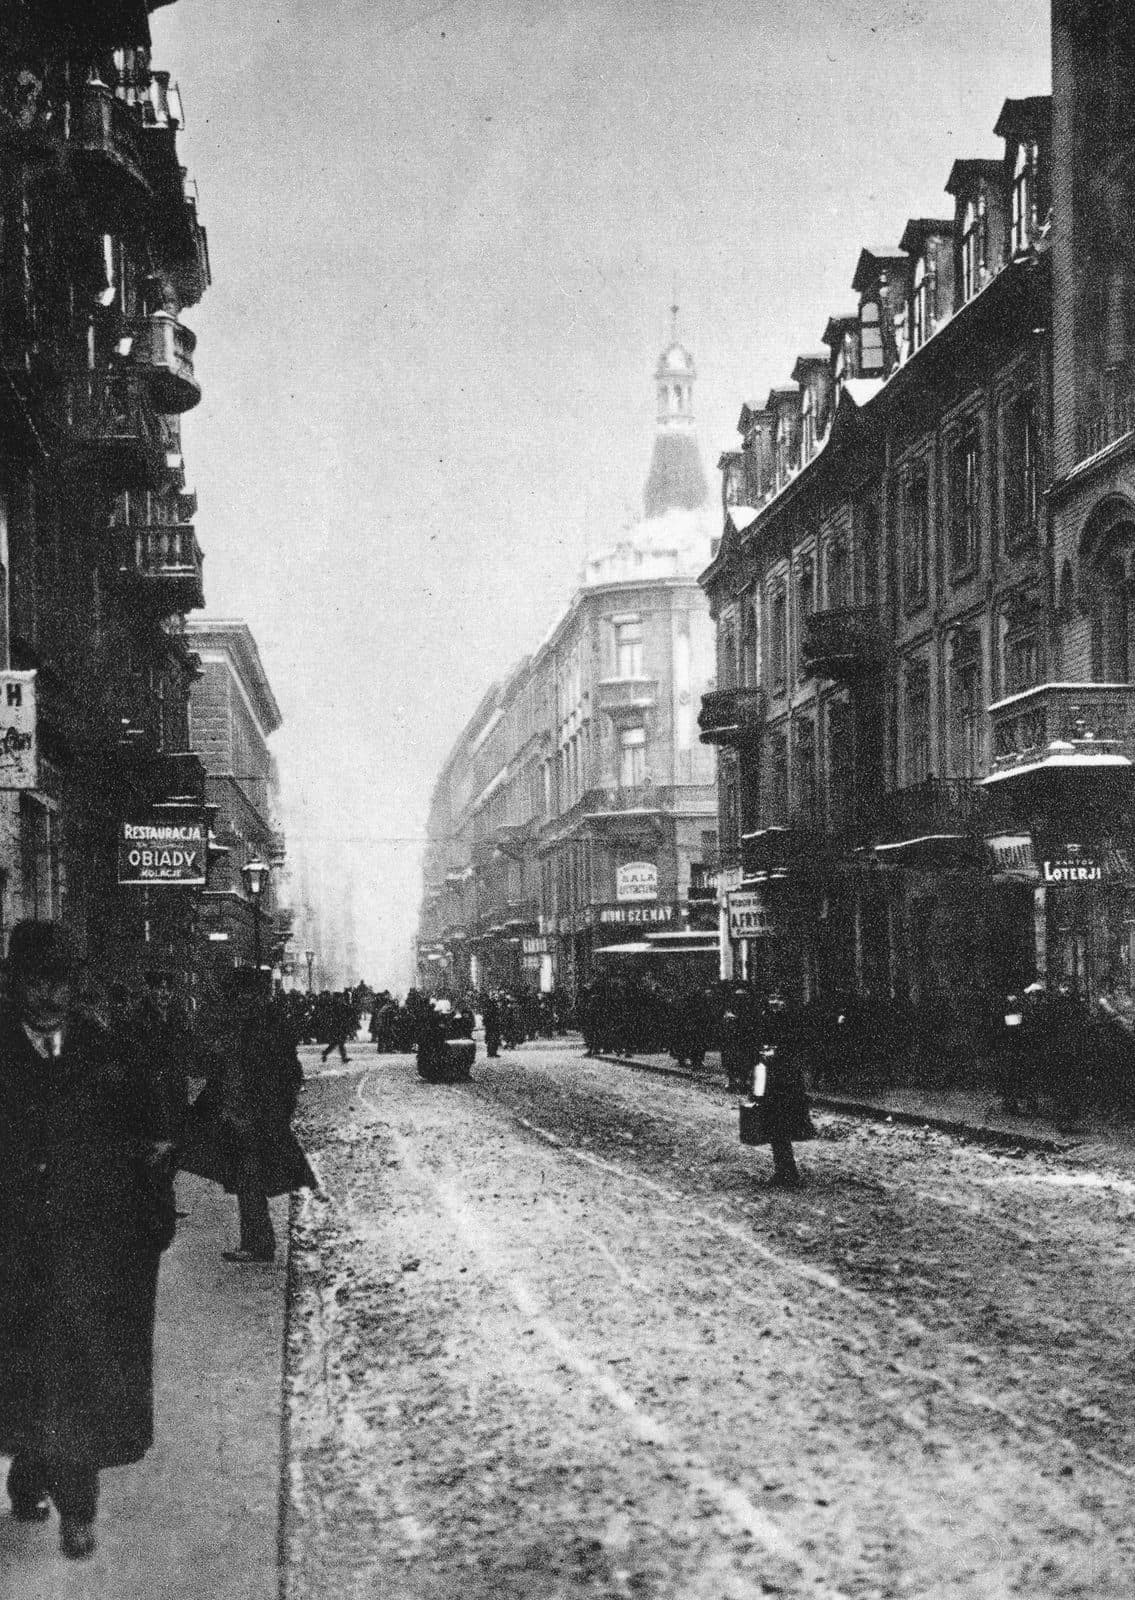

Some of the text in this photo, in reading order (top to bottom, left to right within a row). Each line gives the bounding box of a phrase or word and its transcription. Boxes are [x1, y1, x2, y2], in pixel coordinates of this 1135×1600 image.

[124, 824, 201, 840] RESTAURACJA
[128, 850, 196, 867] OBIADY
[1044, 861, 1102, 881] LOTERJI
